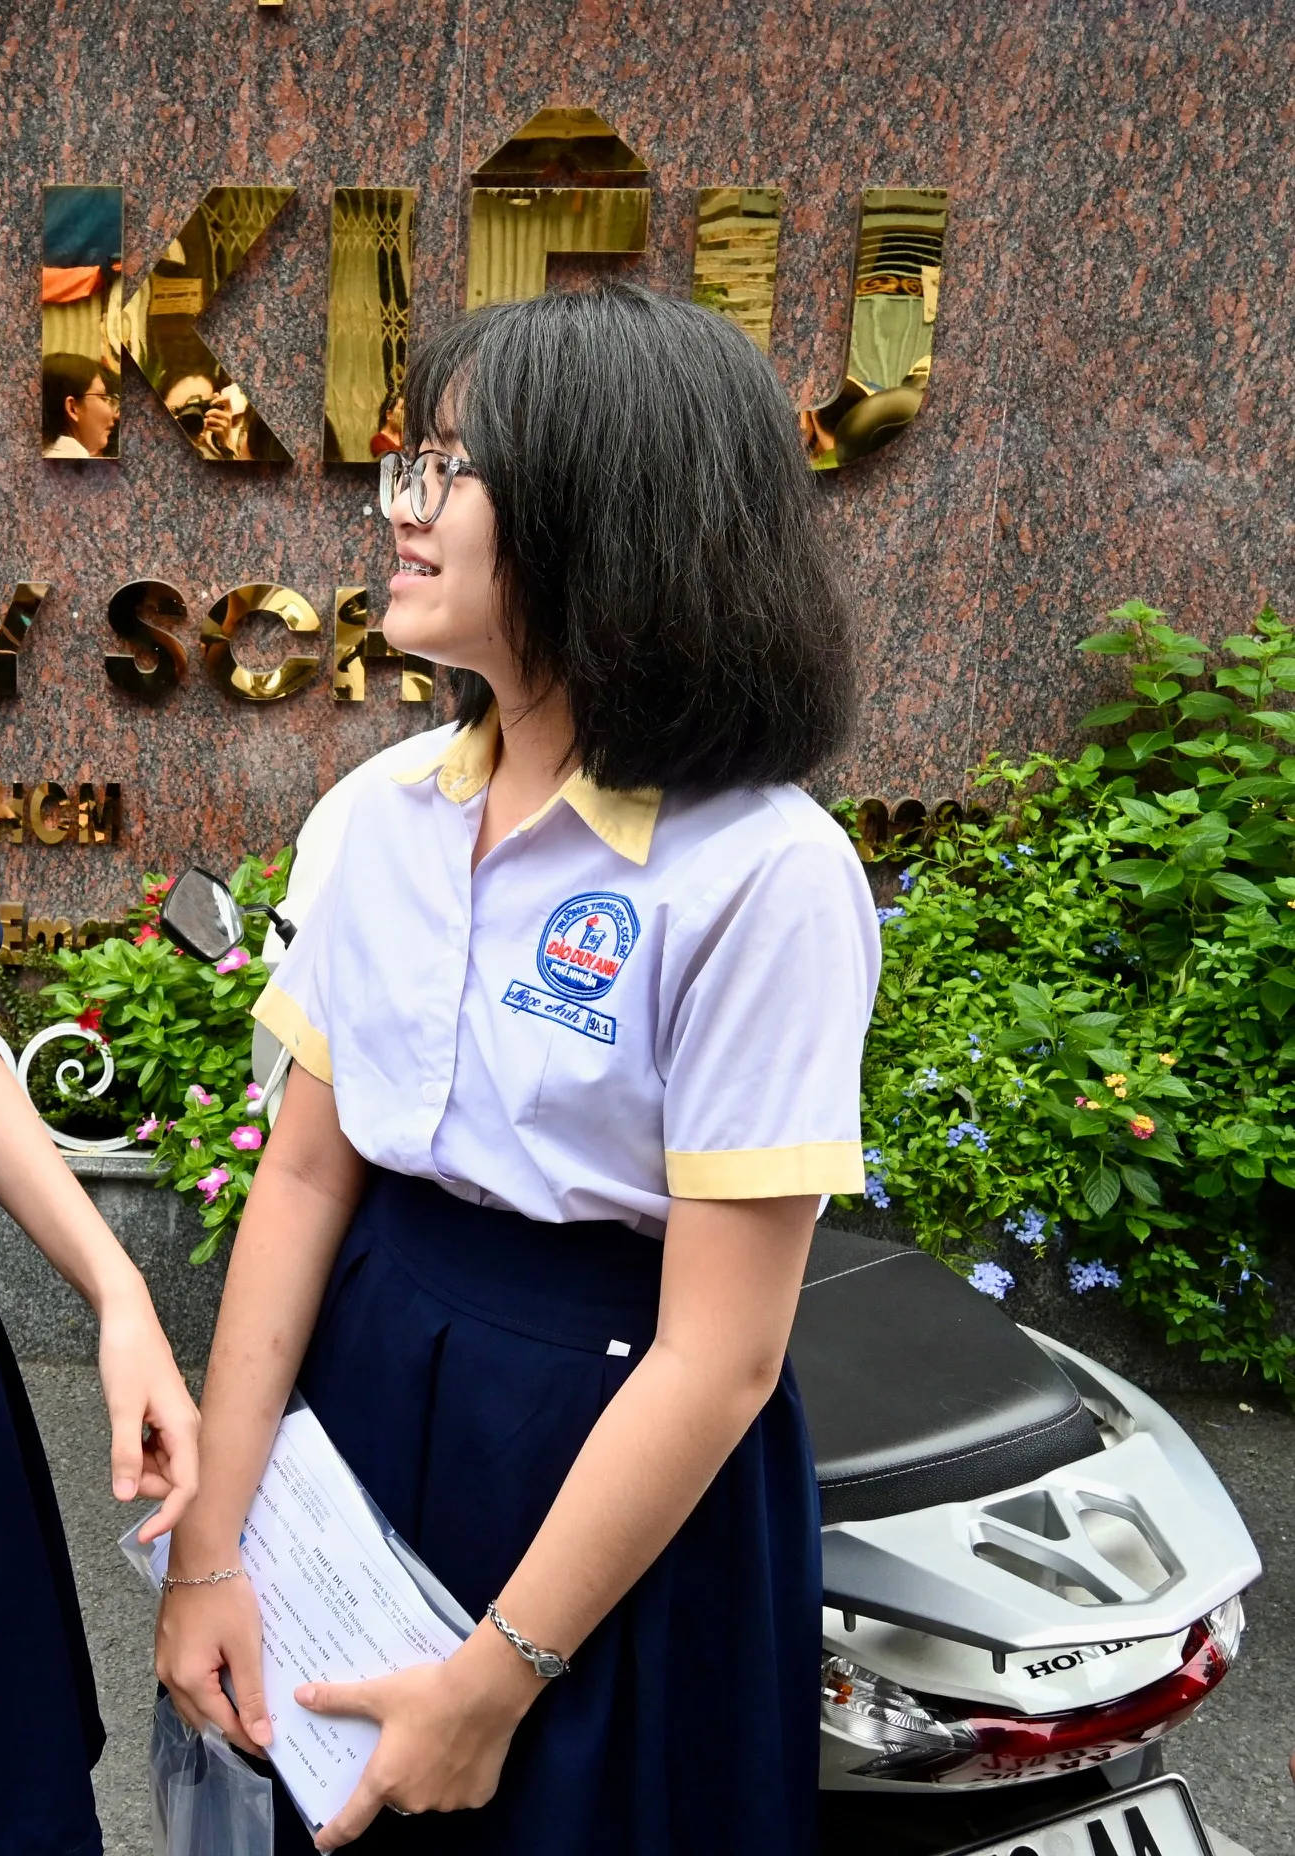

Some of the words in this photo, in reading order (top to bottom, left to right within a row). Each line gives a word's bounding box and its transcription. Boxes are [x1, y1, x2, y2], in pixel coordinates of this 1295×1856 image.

[105, 579, 435, 702] SCH
[570, 948, 596, 969] DUY
[596, 957, 619, 979] ANH
[544, 1003, 584, 1024] Anh
[588, 1017, 610, 1036] 9A1
[247, 1522, 259, 1536] TIN
[311, 1545, 336, 1575] PHIẾU
[342, 1587, 359, 1608] THI
[298, 1565, 317, 1586] ngày
[321, 1594, 357, 1639] 02/06/2026
[309, 1563, 328, 1585] trung
[323, 1582, 339, 1599] học
[333, 1594, 352, 1614] phổ
[345, 1610, 367, 1635] thông
[362, 1632, 379, 1651] năm
[374, 1647, 391, 1666] học
[273, 1654, 286, 1668] Anh
[316, 1643, 331, 1662] ANH
[1023, 1640, 1147, 1680] HOND
[344, 1745, 358, 1761] 9A1
